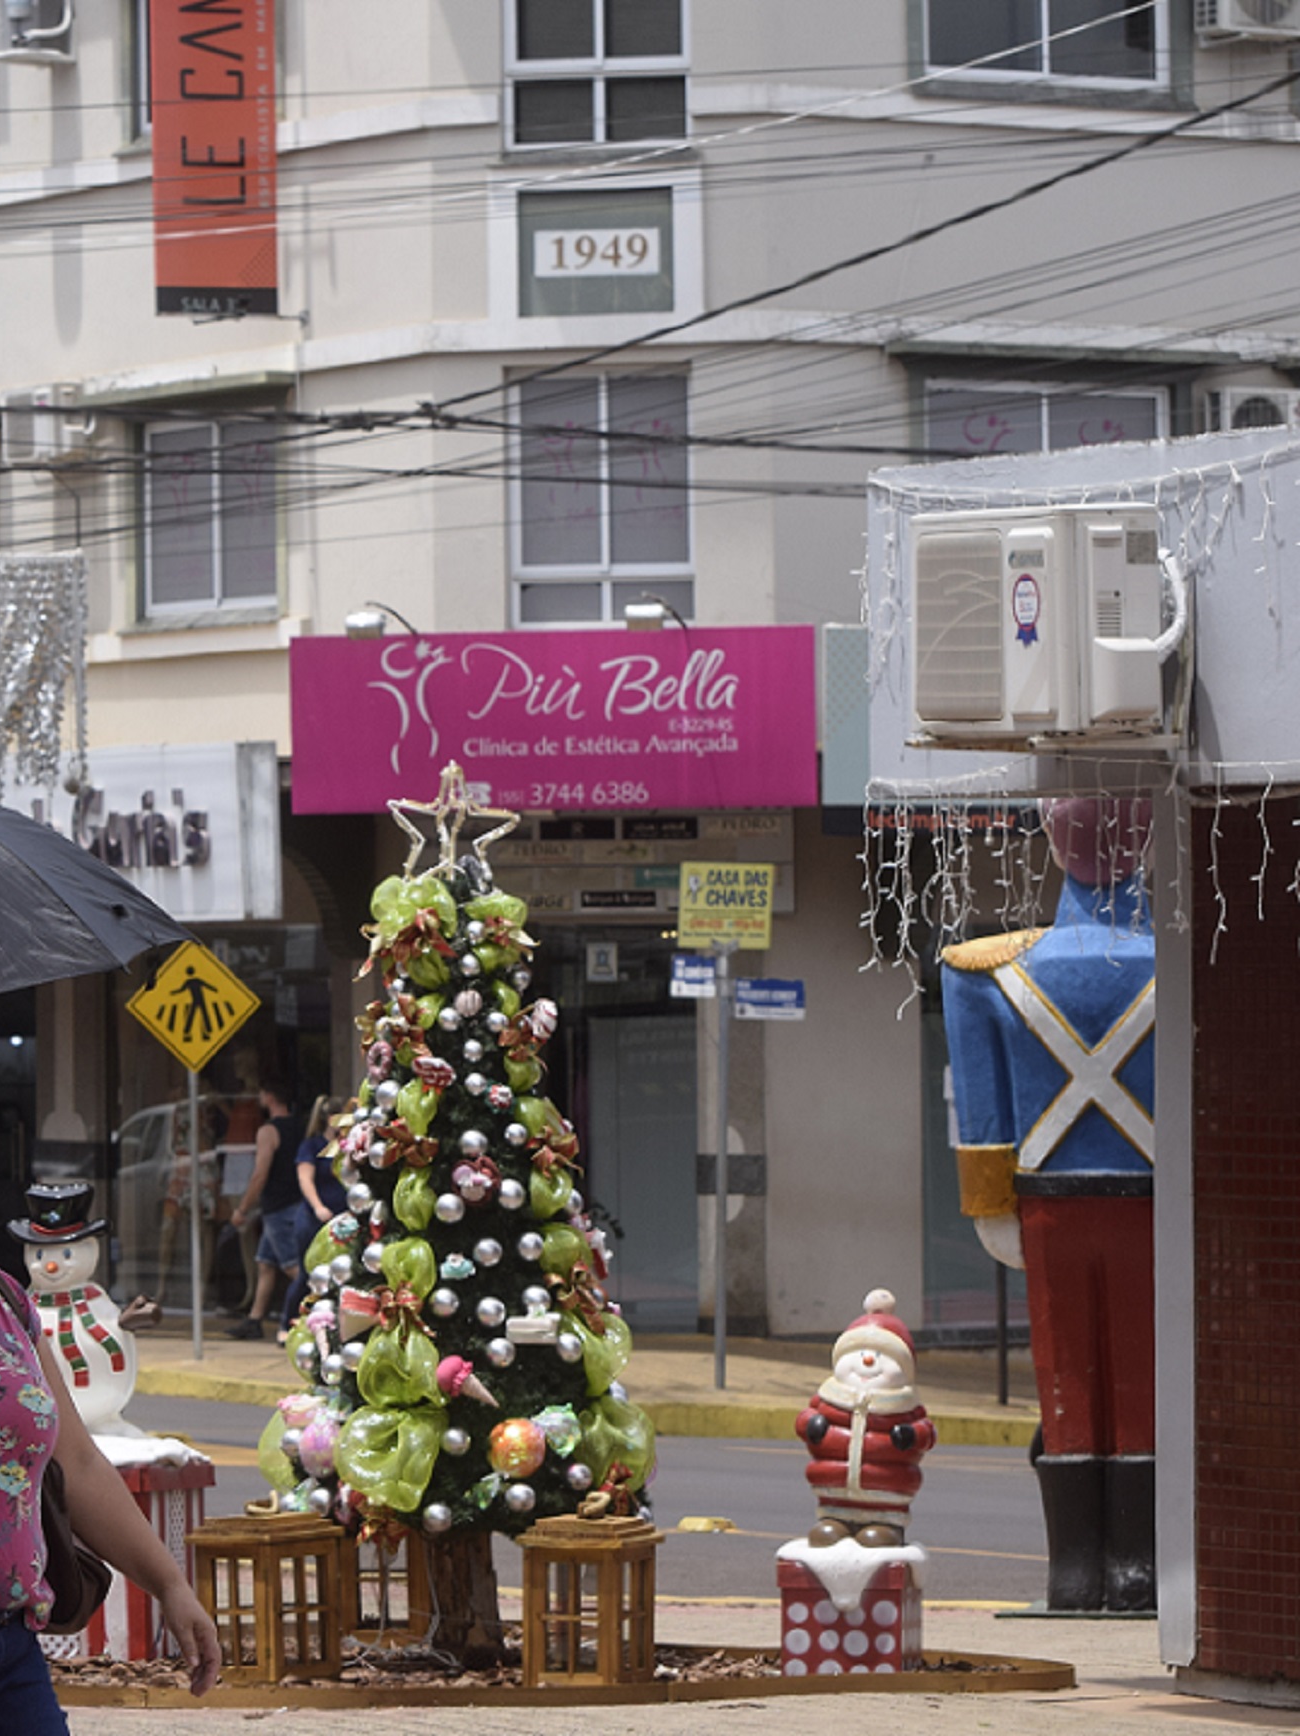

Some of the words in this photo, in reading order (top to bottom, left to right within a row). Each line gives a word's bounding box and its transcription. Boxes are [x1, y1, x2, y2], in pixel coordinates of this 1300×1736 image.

[181, 135, 246, 205] LE
[550, 232, 649, 270] 1949
[599, 649, 740, 721] Bella
[462, 737, 529, 757] Clínica
[533, 736, 560, 755] de
[564, 733, 640, 756] Estética
[644, 731, 739, 758] Avançada
[529, 782, 586, 806] 3744
[591, 780, 650, 804] 6386
[706, 889, 768, 907] CHAVES
